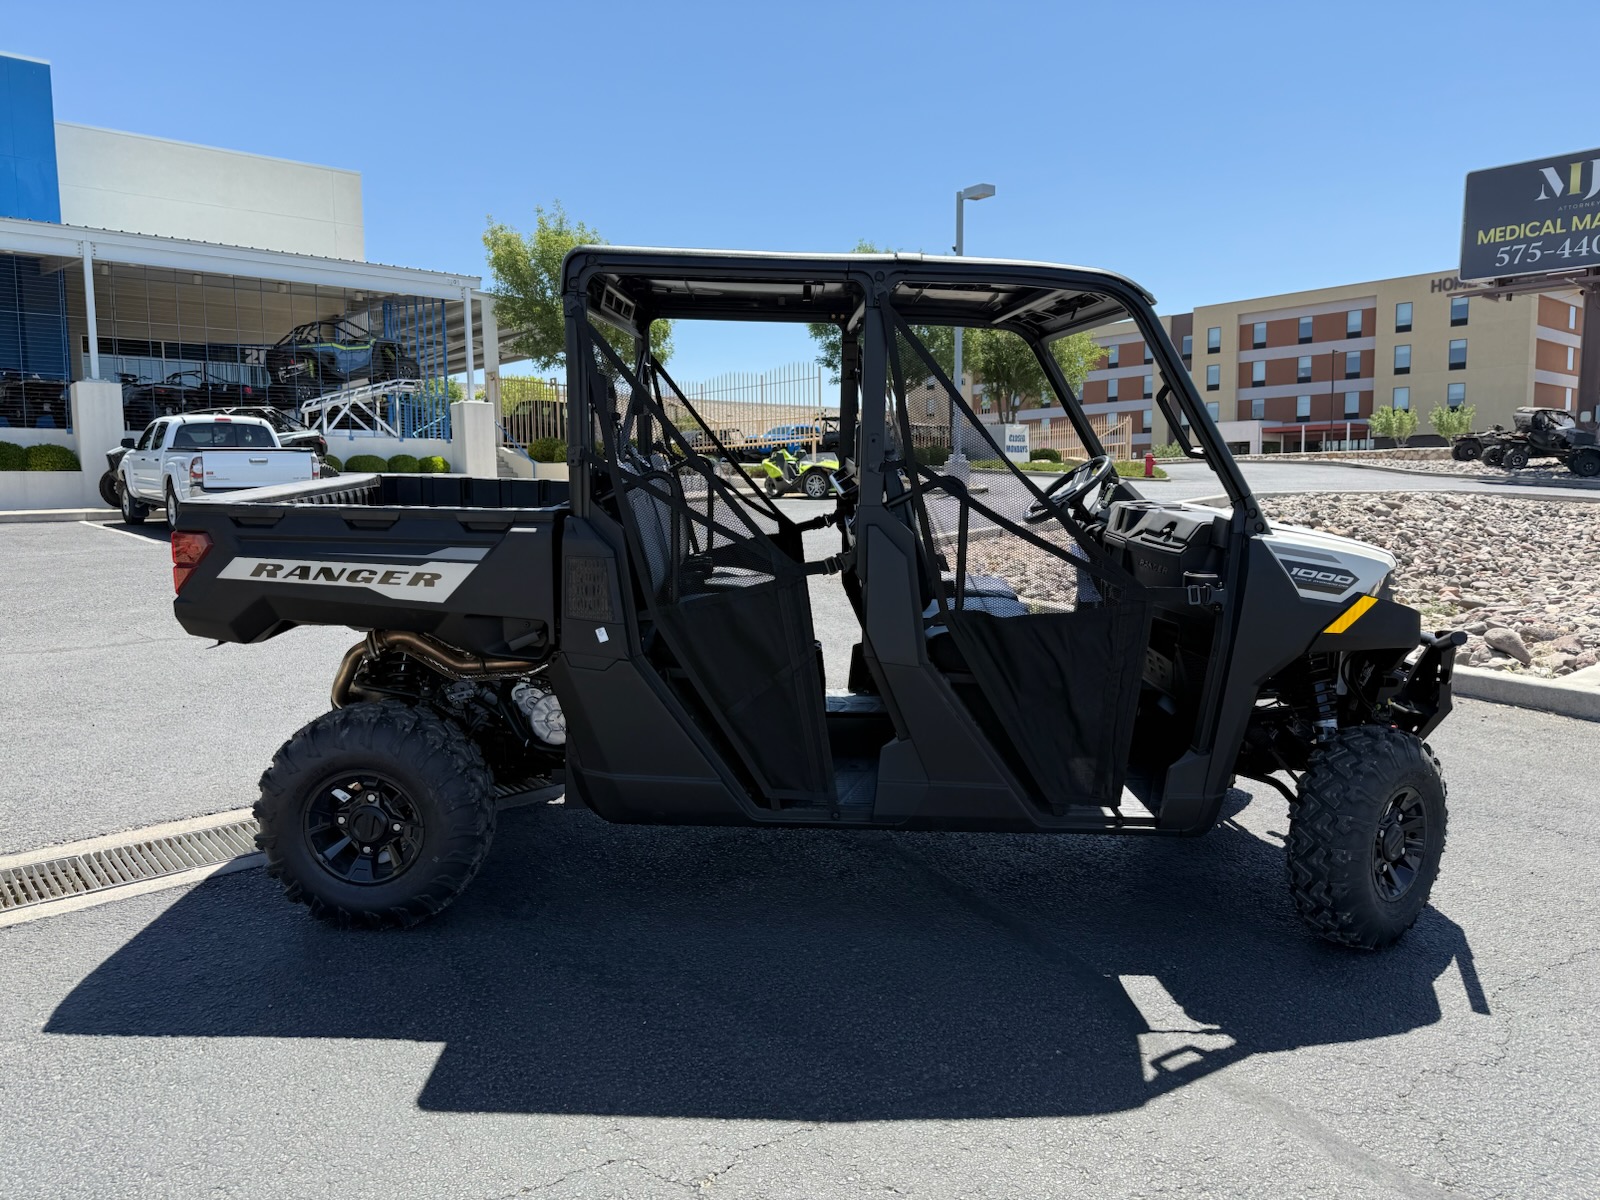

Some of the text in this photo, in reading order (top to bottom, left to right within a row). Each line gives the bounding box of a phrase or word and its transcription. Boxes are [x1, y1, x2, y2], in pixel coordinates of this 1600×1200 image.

[1477, 218, 1566, 245] MEDICAL
[250, 562, 443, 588] RANGER
[1290, 567, 1354, 585] 1000
